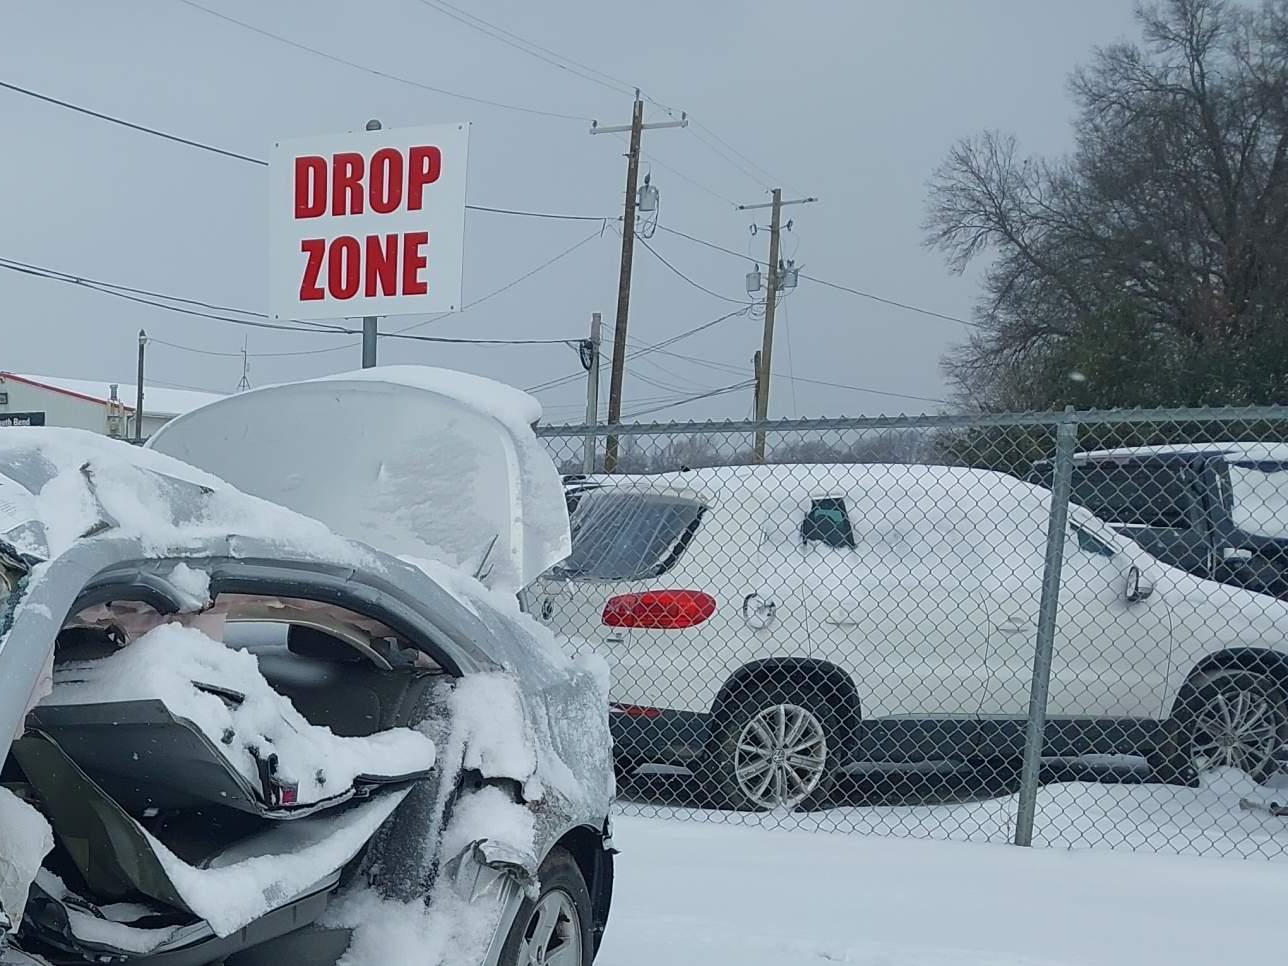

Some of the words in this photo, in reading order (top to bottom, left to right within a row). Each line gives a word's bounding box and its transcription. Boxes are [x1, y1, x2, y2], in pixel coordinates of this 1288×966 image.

[294, 146, 441, 219] DROP
[299, 231, 429, 301] ZONE
[13, 417, 31, 426] Bend
